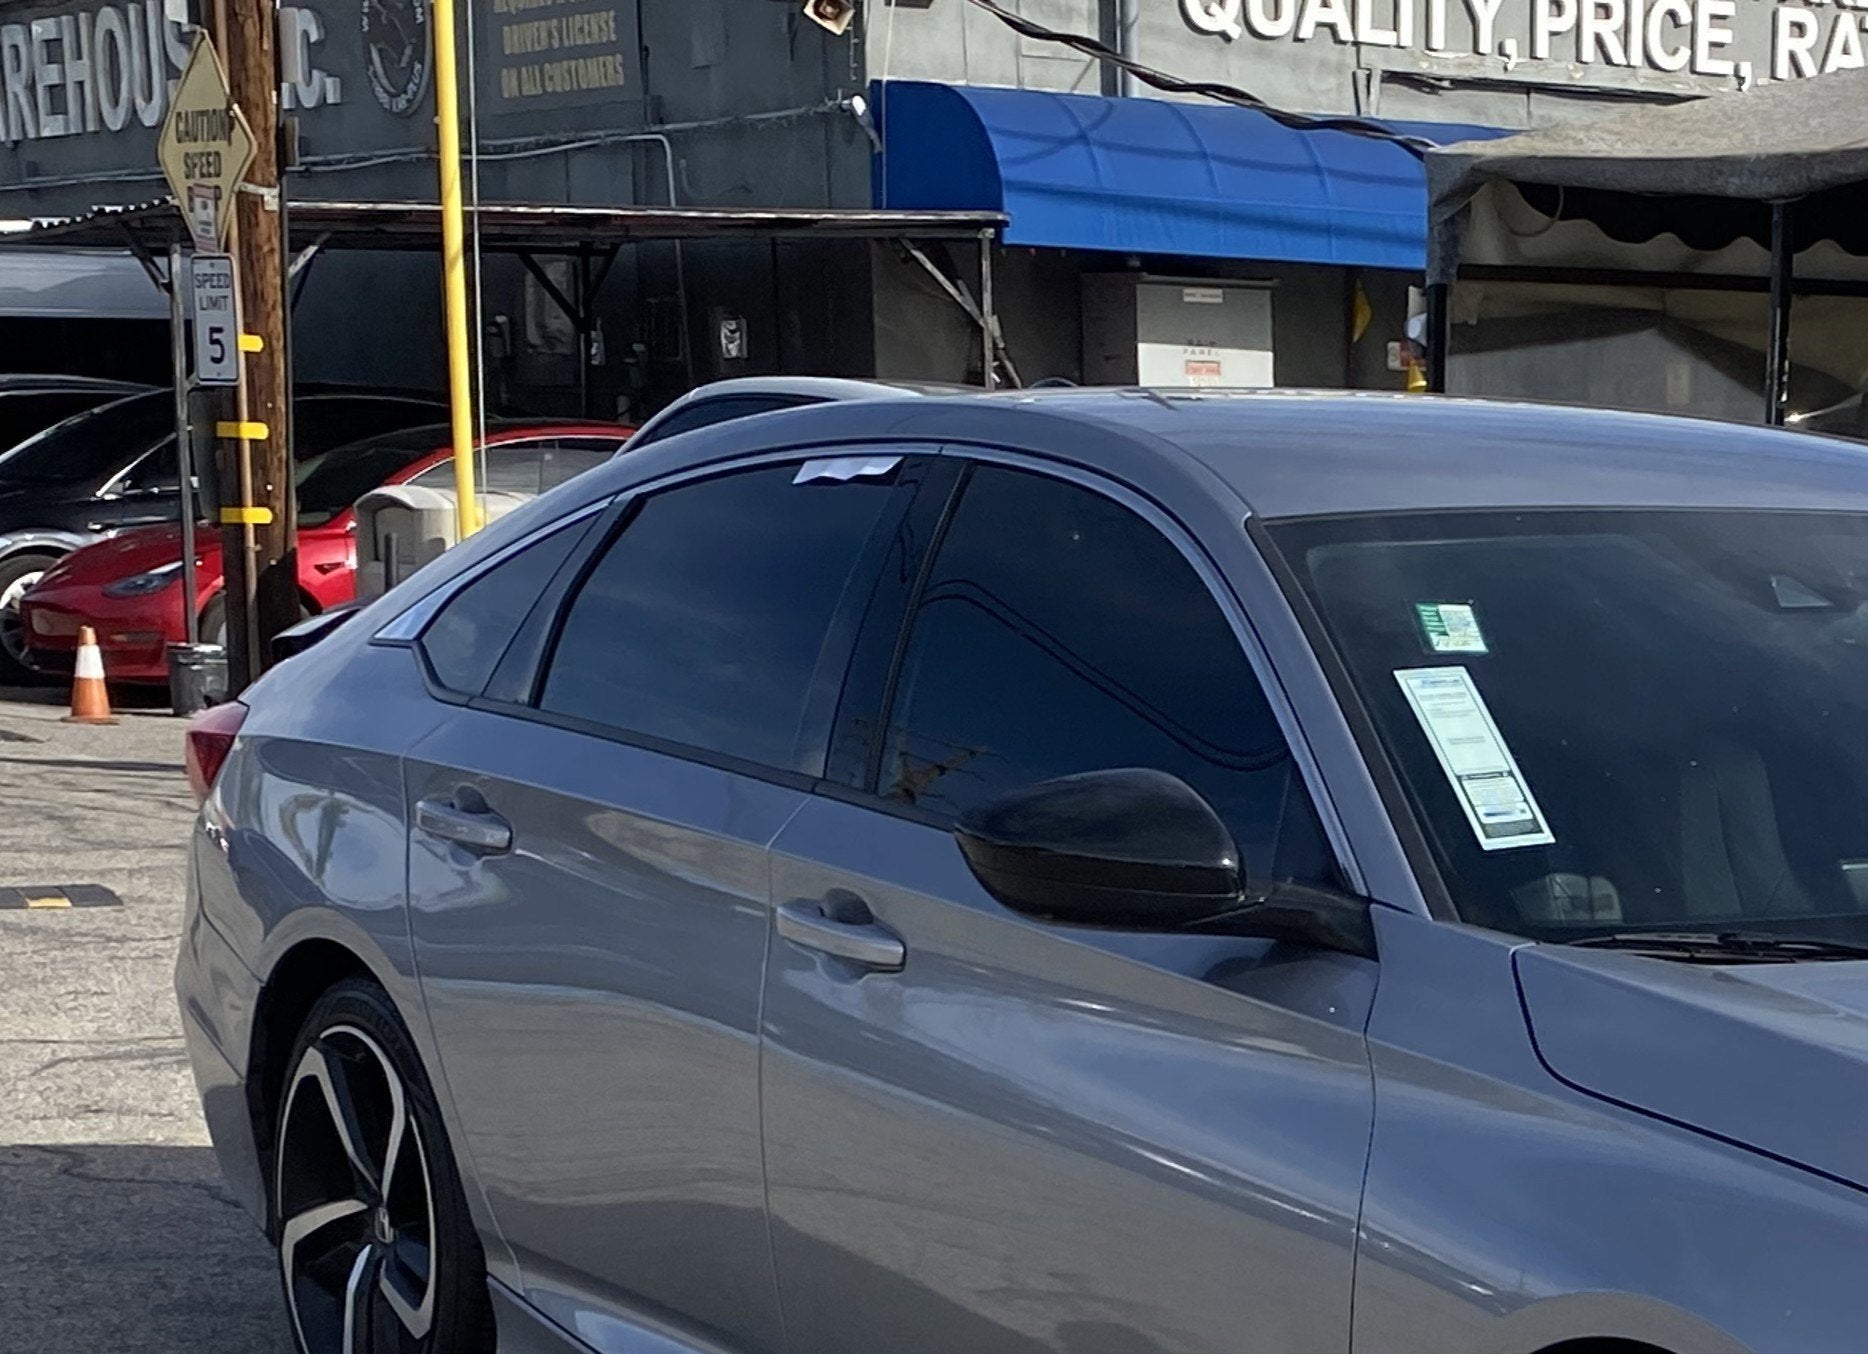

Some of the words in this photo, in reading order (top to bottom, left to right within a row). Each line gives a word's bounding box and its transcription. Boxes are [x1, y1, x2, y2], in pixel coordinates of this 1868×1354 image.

[562, 9, 616, 47] LICENSE
[1537, 0, 1752, 93] PRICE,
[520, 64, 543, 96] ALL
[543, 53, 624, 92] CUSTOMERS
[176, 109, 228, 143] CAUTION
[183, 151, 222, 179] SPEED
[195, 272, 230, 289] SPEED
[200, 295, 229, 311] LIMIT
[208, 326, 226, 365] 5
